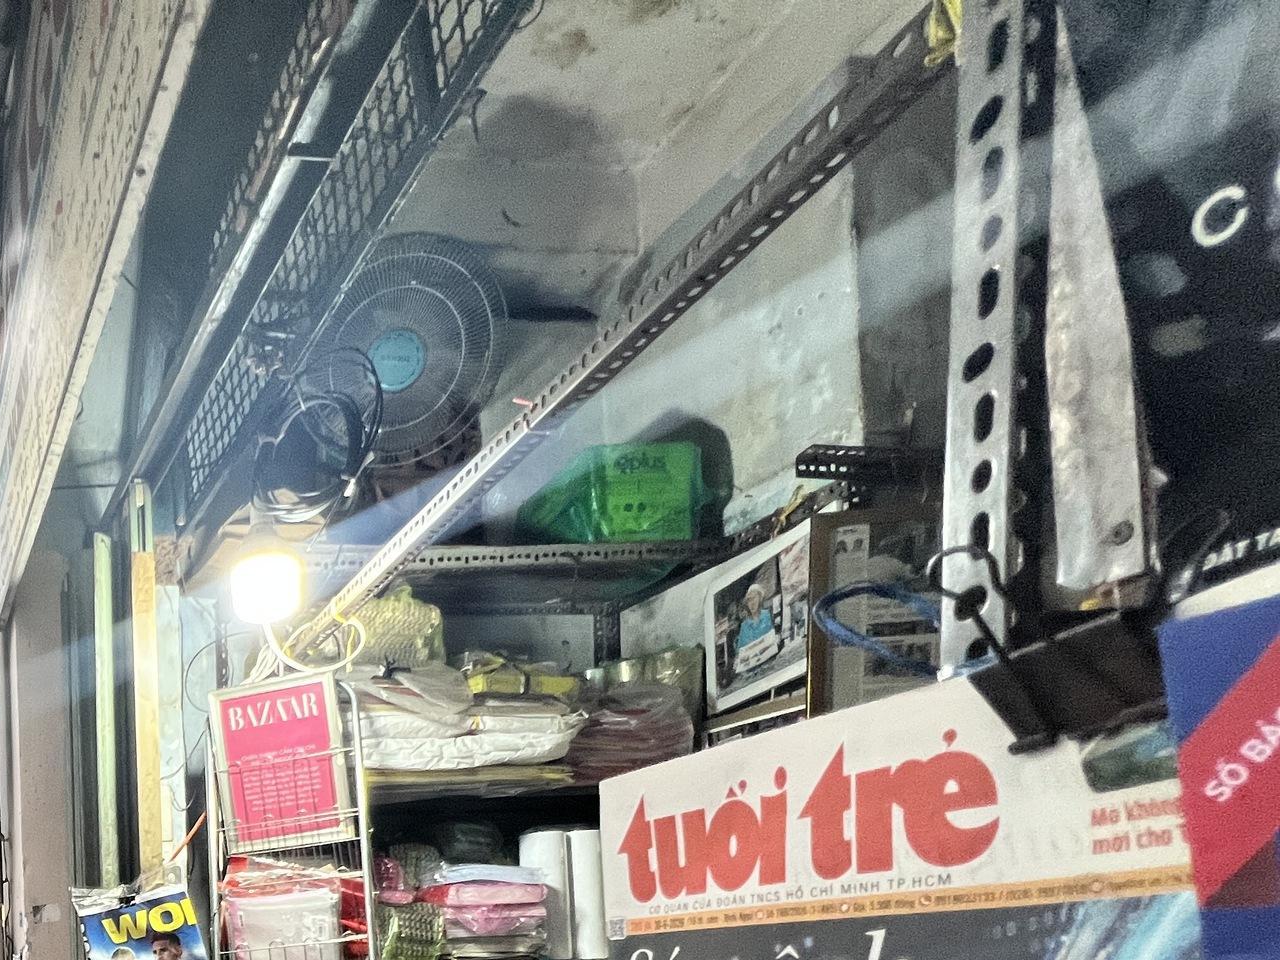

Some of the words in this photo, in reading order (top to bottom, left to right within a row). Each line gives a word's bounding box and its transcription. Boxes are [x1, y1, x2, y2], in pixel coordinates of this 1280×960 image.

[228, 692, 319, 732] BAZAAR
[1204, 758, 1250, 802] SỐ
[617, 765, 791, 903] tuổi
[797, 728, 1001, 876] trẻ
[1136, 828, 1173, 848] cho
[750, 891, 780, 905] TNCS
[786, 885, 804, 900] HỒ
[810, 883, 834, 898] CHÍ
[840, 880, 881, 894] MINH
